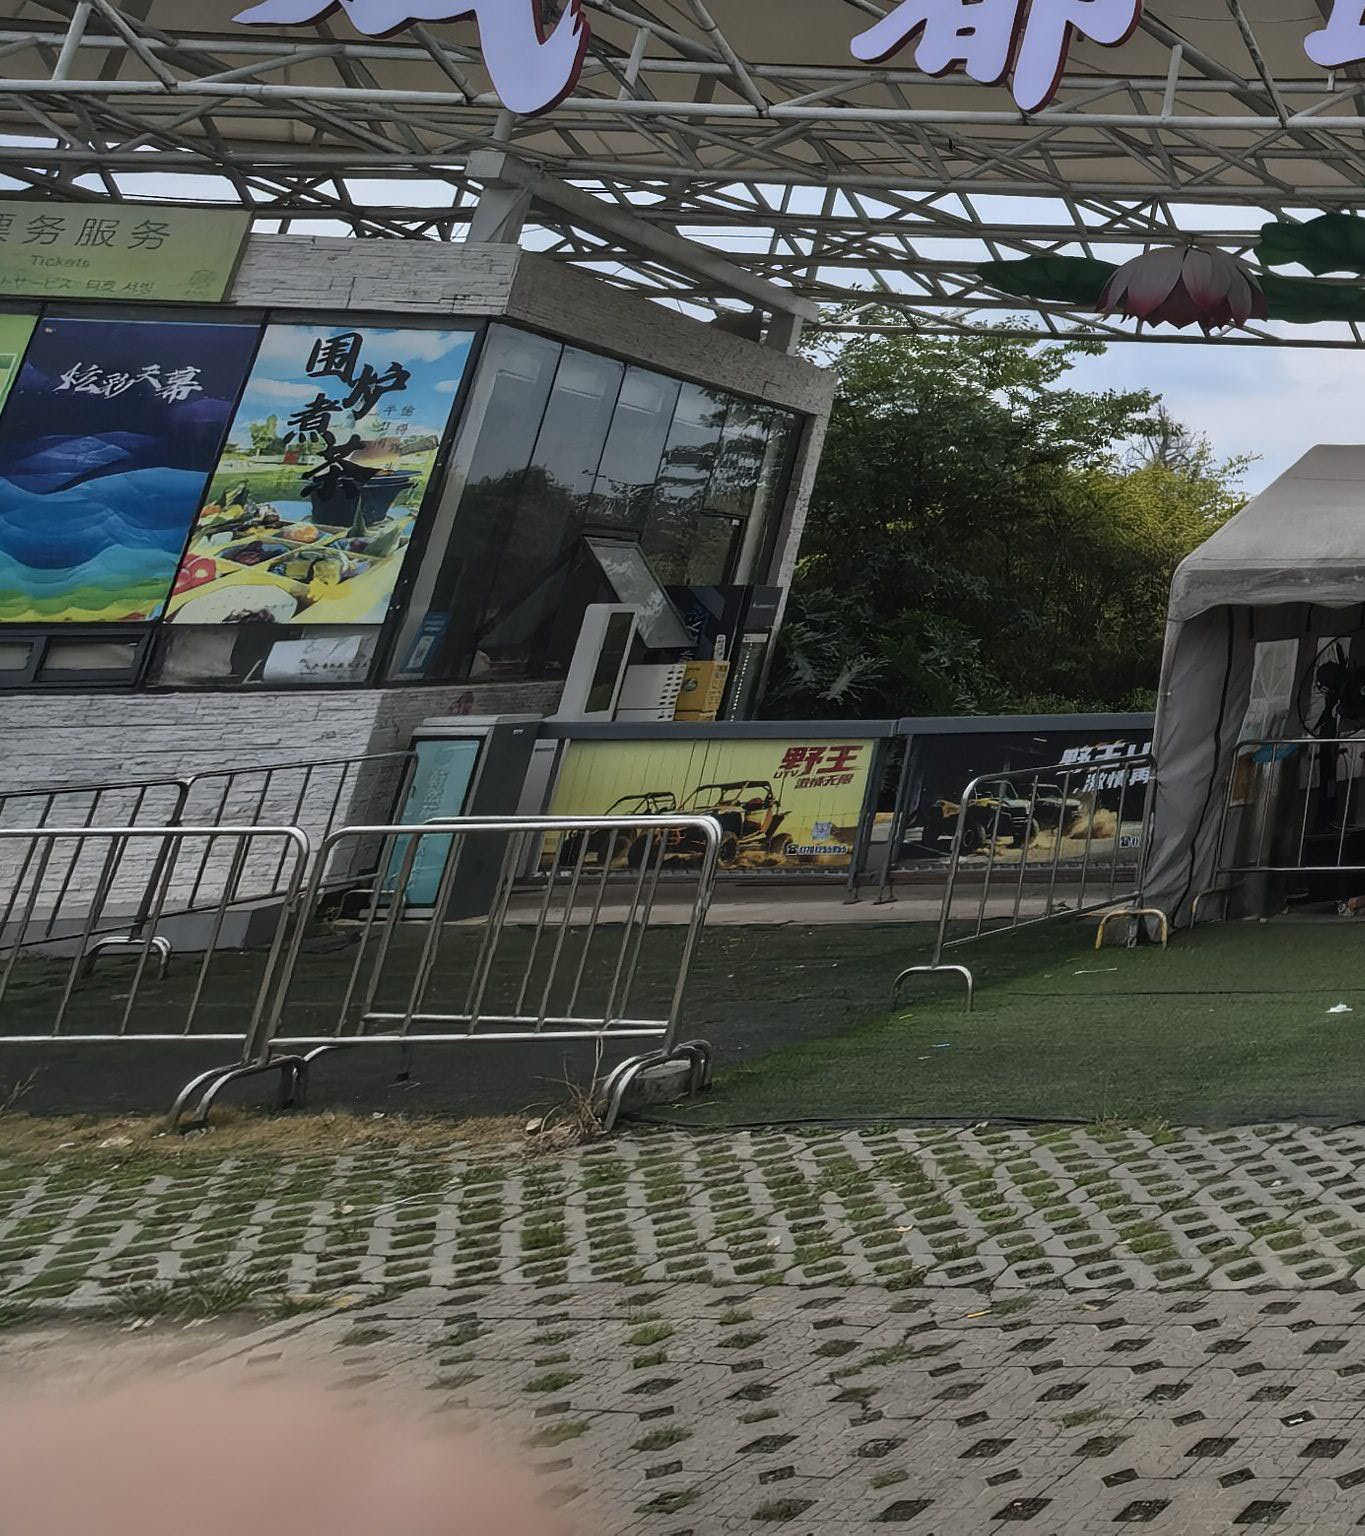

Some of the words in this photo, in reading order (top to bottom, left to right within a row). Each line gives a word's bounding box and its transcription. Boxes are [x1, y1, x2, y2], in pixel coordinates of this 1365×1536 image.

[31, 254, 90, 269] Tickets
[53, 362, 203, 404] 炫彩天幕
[778, 745, 864, 777] 野王
